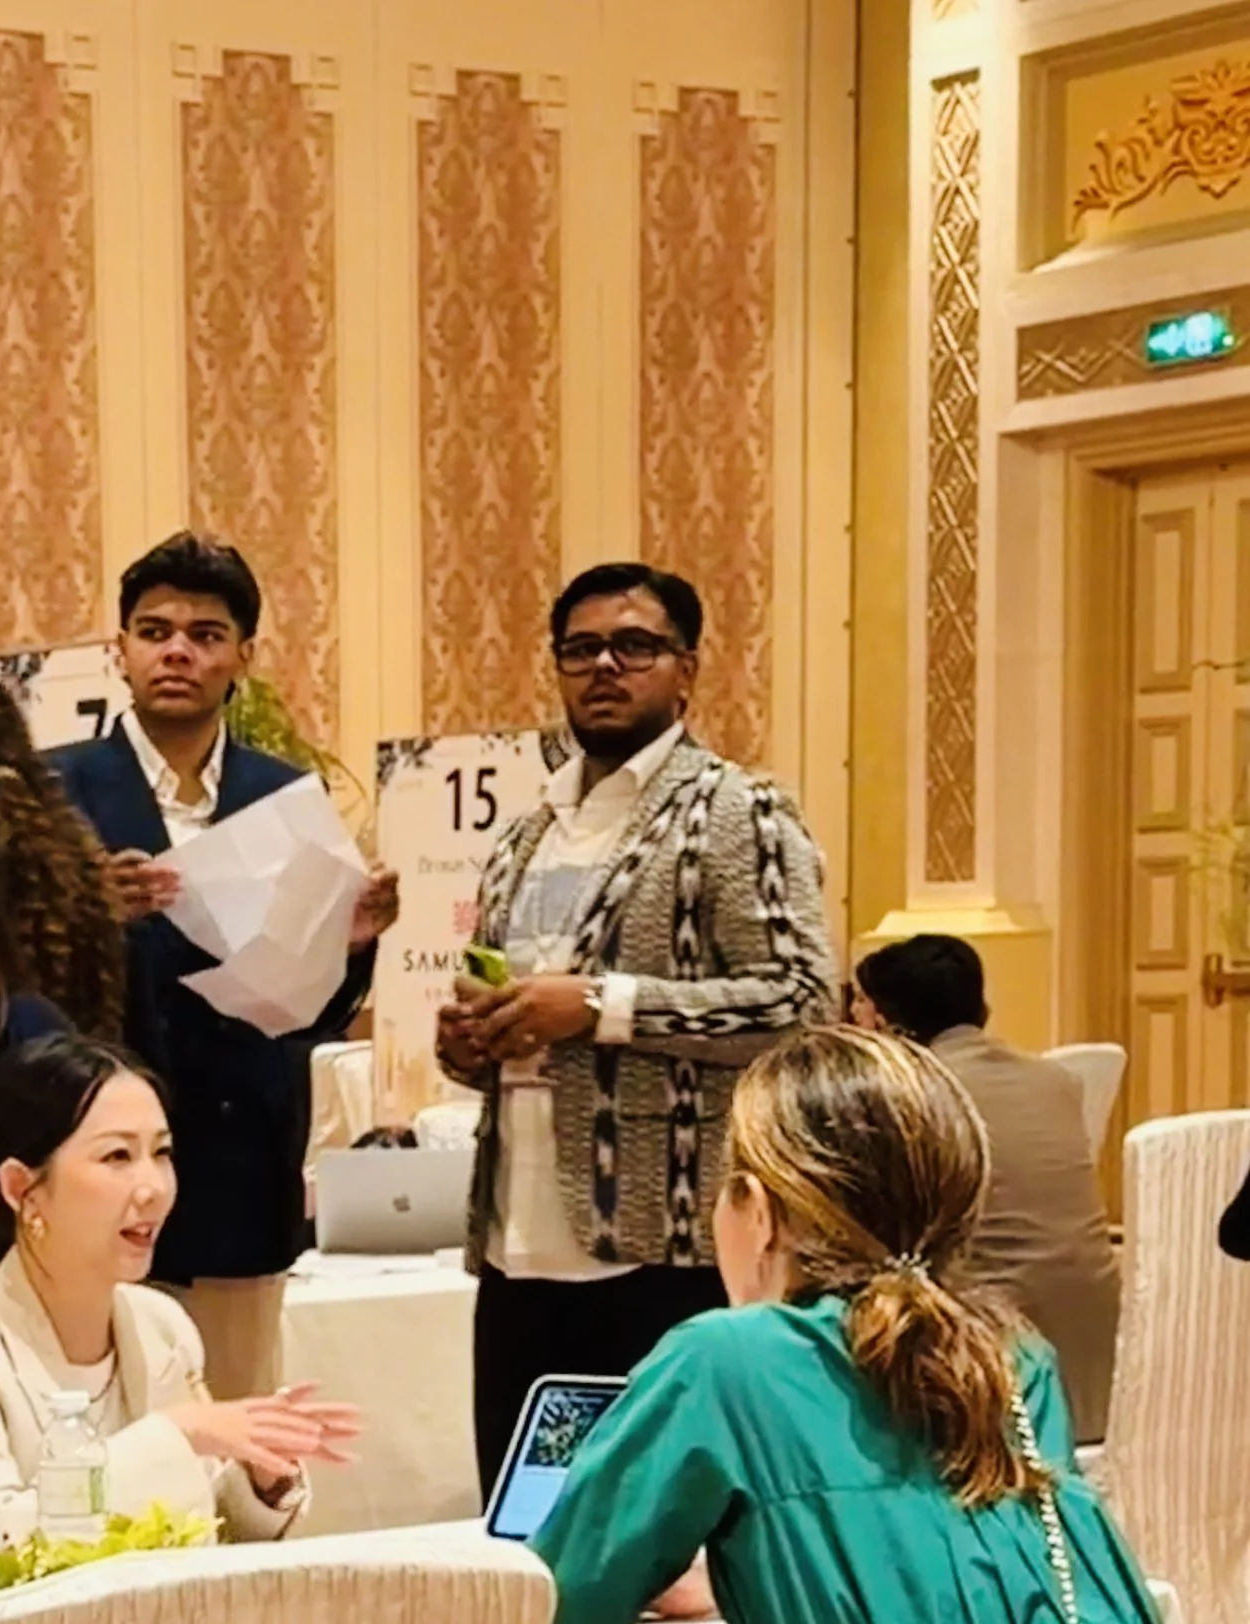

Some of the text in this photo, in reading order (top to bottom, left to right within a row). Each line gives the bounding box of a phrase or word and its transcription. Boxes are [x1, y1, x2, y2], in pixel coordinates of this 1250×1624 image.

[76, 698, 108, 739] 7
[445, 767, 498, 831] 15
[402, 947, 463, 973] SAMU
